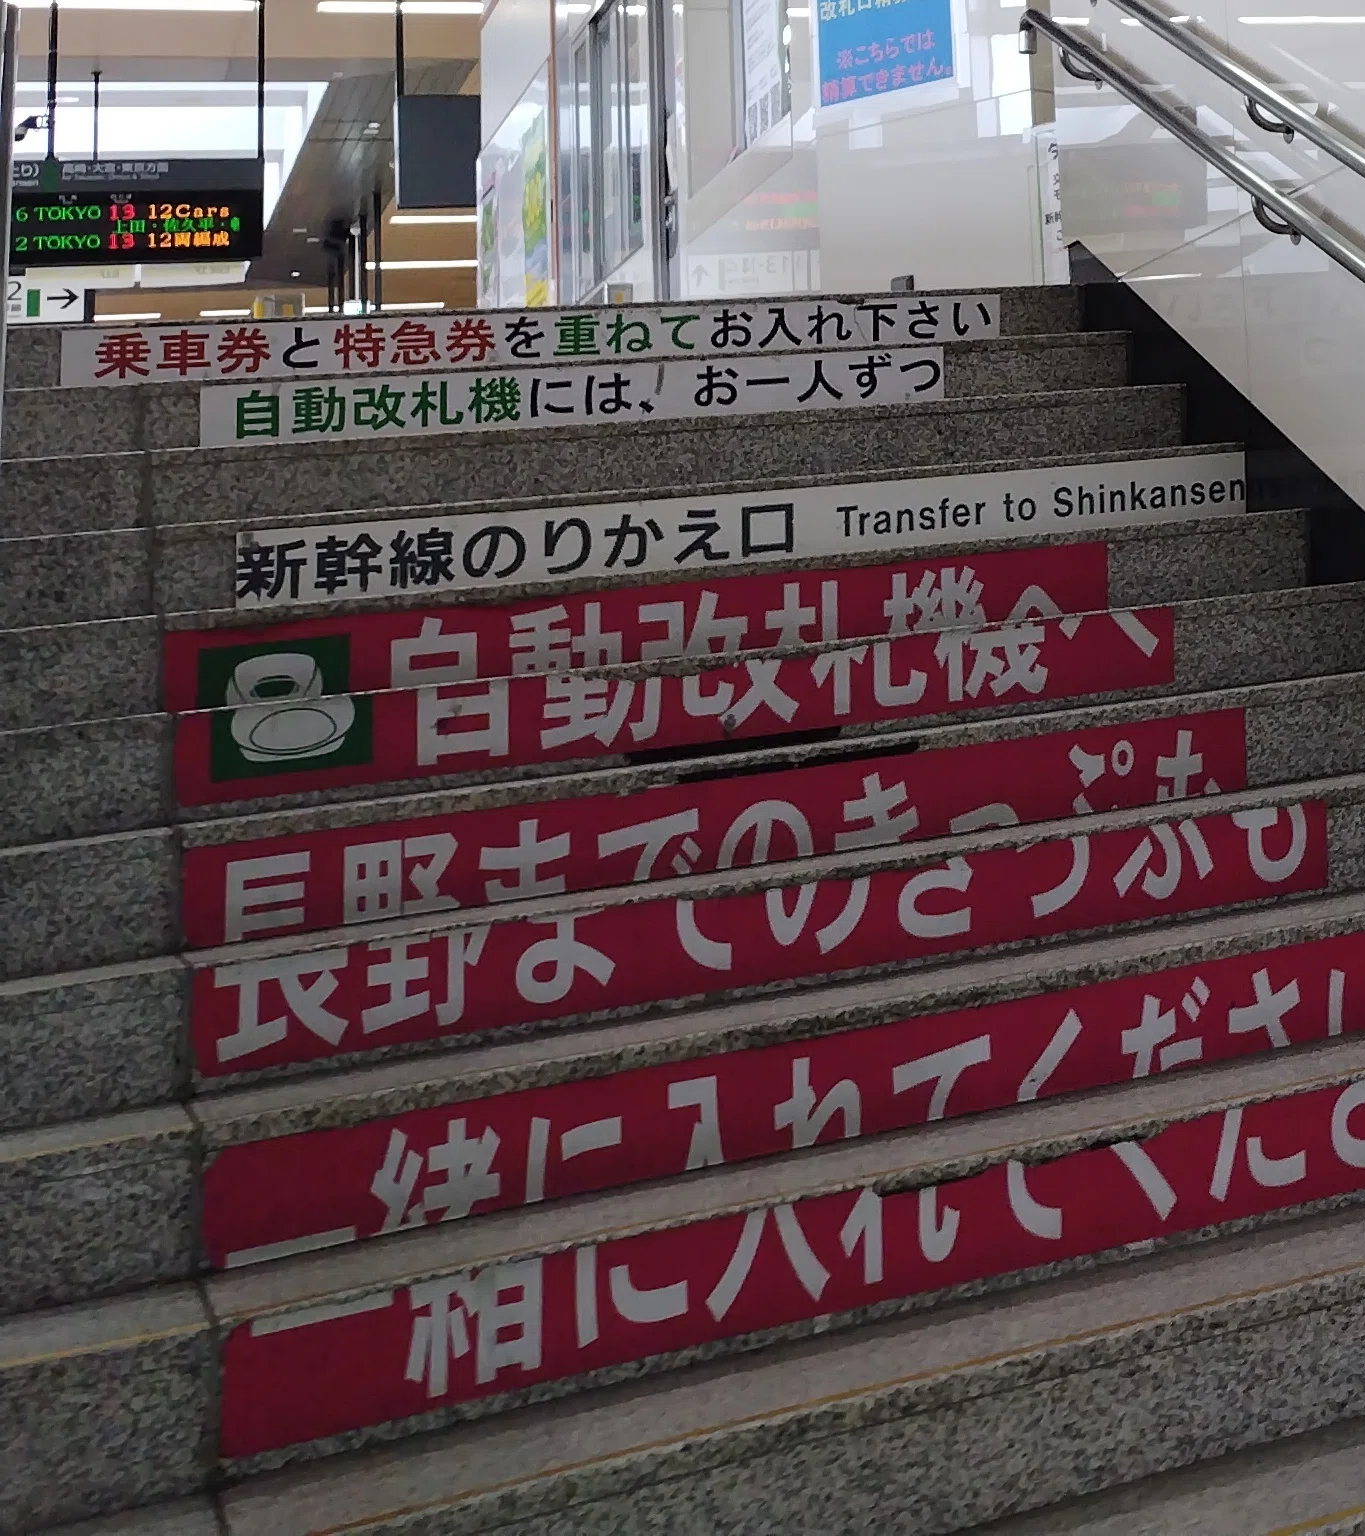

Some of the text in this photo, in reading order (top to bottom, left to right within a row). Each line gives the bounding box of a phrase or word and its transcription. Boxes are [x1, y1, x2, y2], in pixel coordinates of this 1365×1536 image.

[33, 204, 102, 221] TOKYO
[109, 204, 136, 221] 13
[33, 234, 101, 250] TOKYO
[108, 232, 136, 250] 13
[94, 299, 993, 380] 乗車券と特急券を重ねてお入れ下さい
[234, 354, 943, 440] 自動改札機には、お一人ずつ
[836, 474, 1247, 539] Transfer to Shinkansen
[235, 502, 796, 600] 新幹線のりかえ口
